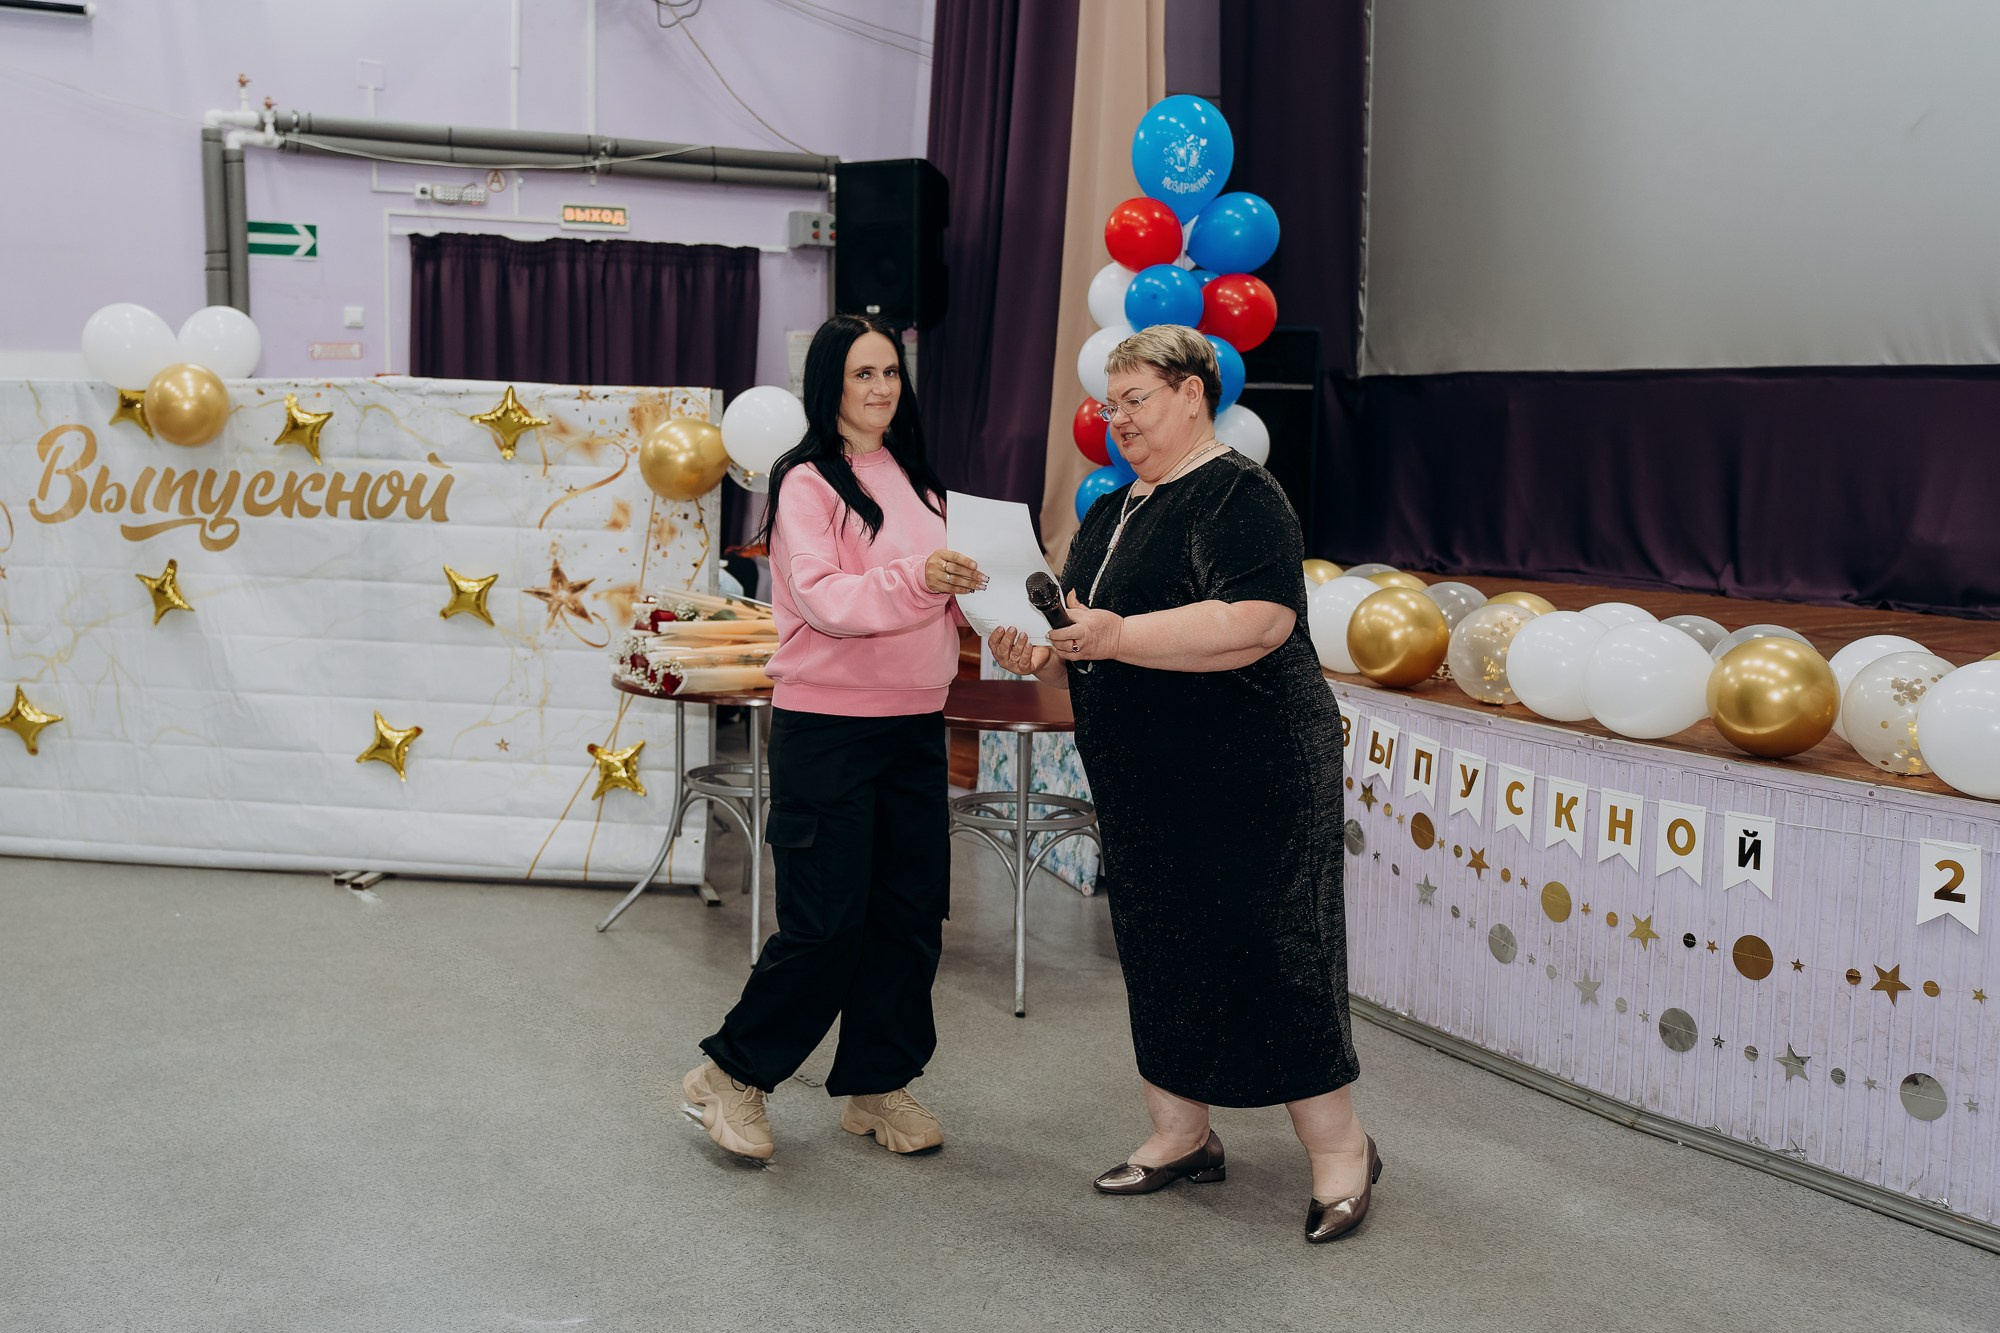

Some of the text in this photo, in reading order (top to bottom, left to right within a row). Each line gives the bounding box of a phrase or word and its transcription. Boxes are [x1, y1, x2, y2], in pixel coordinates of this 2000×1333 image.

[563, 207, 626, 225] ВЫХОД
[29, 424, 455, 552] Выпускной
[1341, 715, 1967, 904] ВЫПУСКНОЙ 2
